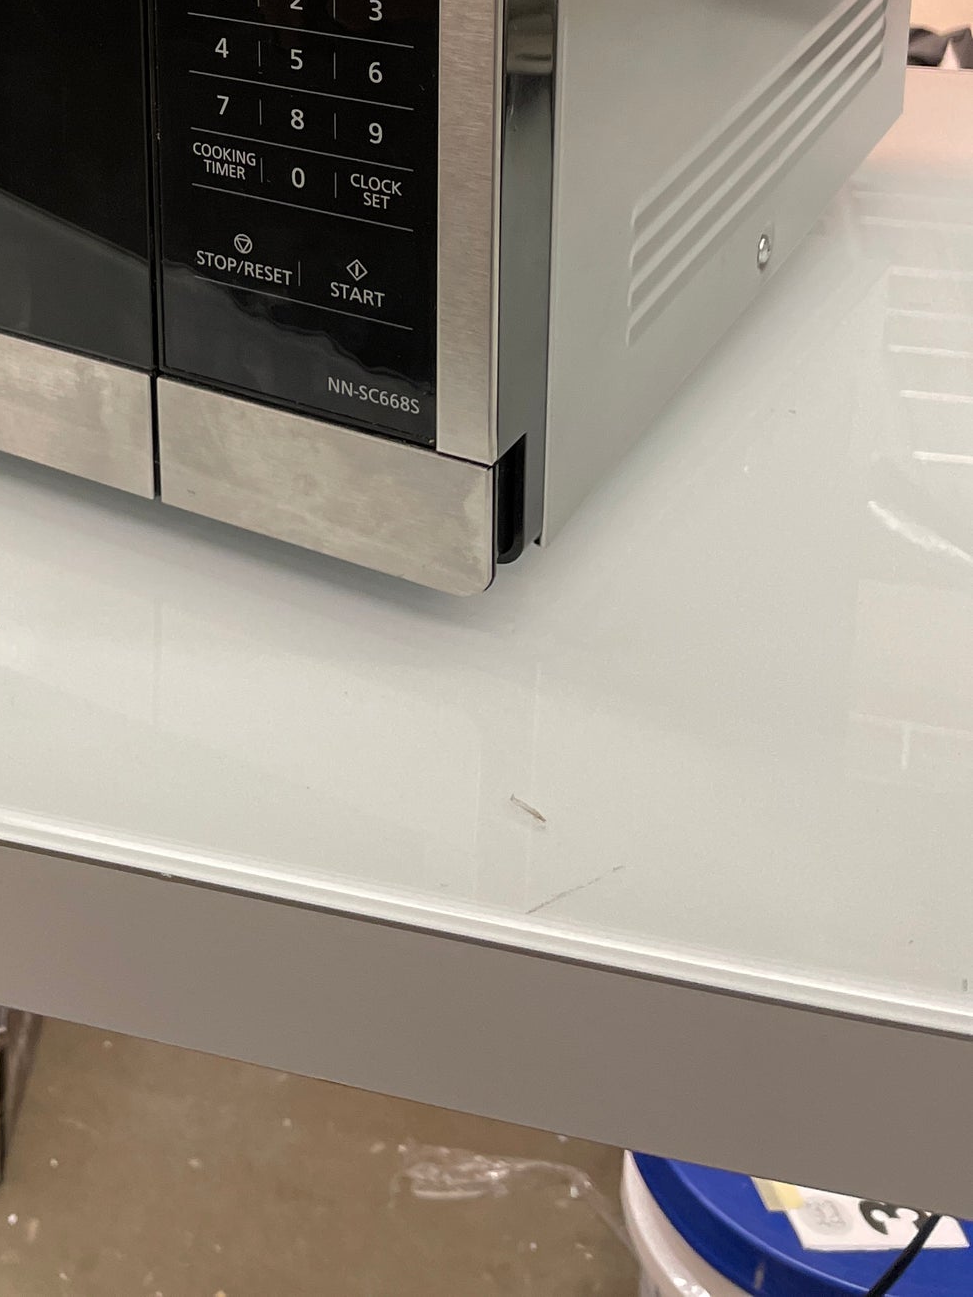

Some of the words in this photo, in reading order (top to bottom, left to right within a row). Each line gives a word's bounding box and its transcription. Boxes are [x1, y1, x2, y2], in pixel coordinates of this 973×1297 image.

[368, 0, 383, 21] 3
[214, 37, 230, 59] 4
[290, 48, 303, 70] 5
[368, 61, 383, 84] 6
[216, 95, 230, 116] 7
[290, 108, 305, 130] 8
[368, 122, 383, 144] 9
[192, 142, 257, 167] COOKING
[203, 159, 246, 180] TIMER
[291, 167, 306, 189] 0
[350, 173, 402, 196] CLOCK
[363, 192, 390, 210] SET
[196, 249, 293, 286] STOP/RESET
[330, 281, 385, 308] START
[327, 376, 420, 415] NN-SC668S
